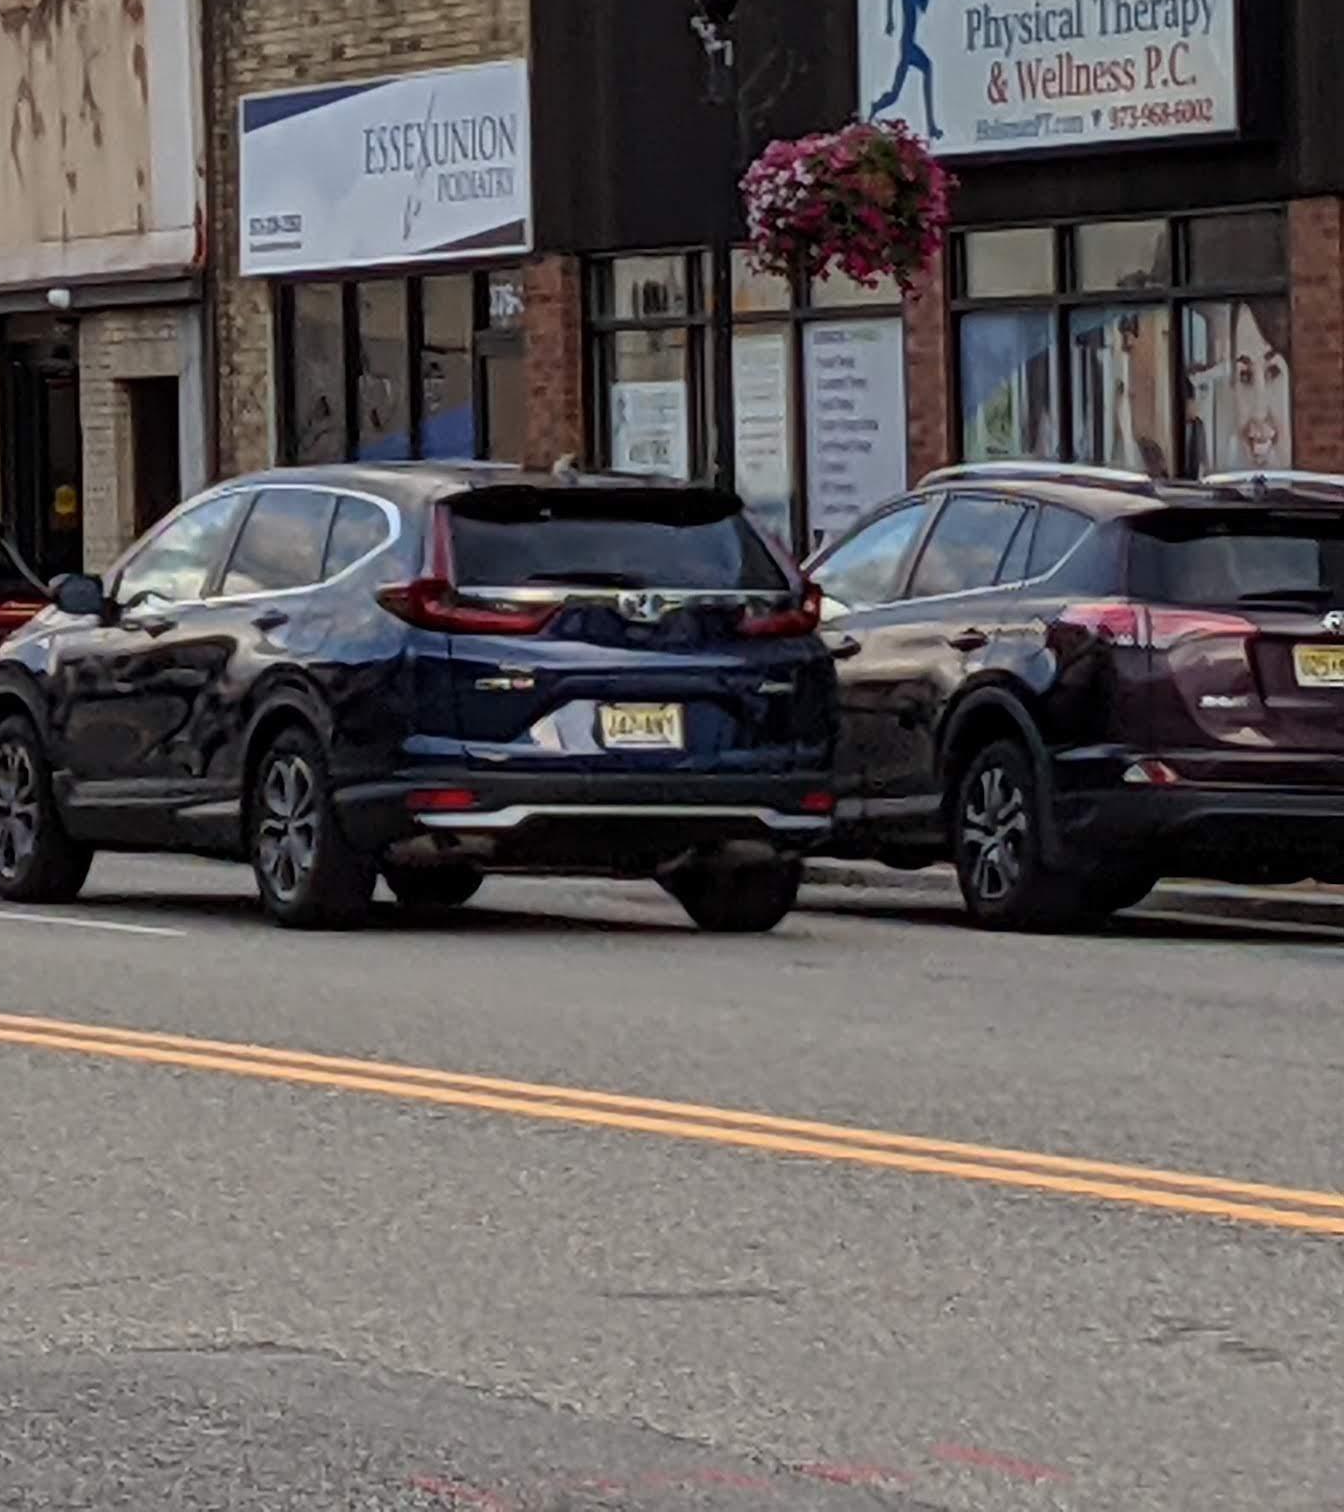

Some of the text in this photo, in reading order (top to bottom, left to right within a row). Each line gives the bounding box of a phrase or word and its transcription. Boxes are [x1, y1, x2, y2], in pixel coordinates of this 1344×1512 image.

[986, 42, 1197, 104] & Wellness P.C.
